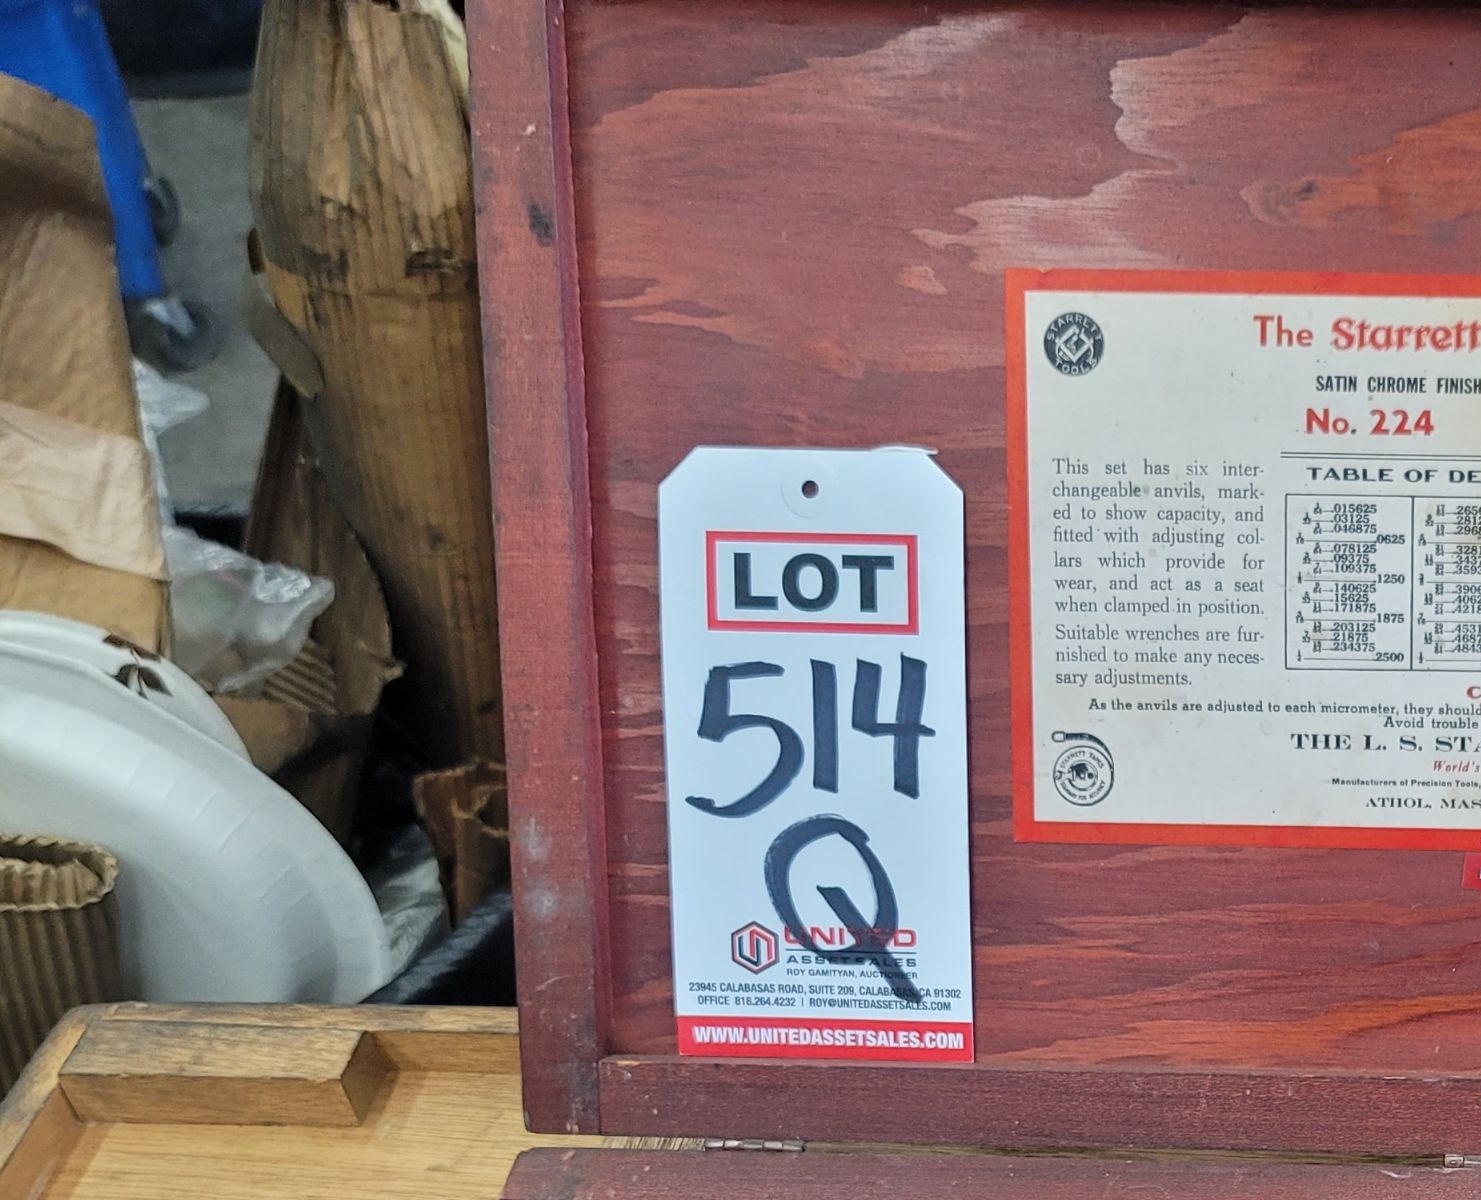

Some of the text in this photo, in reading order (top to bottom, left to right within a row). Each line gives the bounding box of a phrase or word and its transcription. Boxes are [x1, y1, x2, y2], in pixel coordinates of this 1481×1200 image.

[1047, 314, 1103, 342] STARRETT
[1253, 314, 1314, 347] The
[1056, 358, 1097, 376] TOOLS
[1315, 375, 1481, 395] SATIN CHROME FINISH
[1306, 408, 1435, 436] No. 224
[1052, 457, 1264, 477] This set has six inter-
[1306, 467, 1394, 482] TABLE
[1403, 469, 1438, 483] OF
[1052, 480, 1264, 501] changeable anvils, mark-
[1053, 503, 1264, 525] ed to show capacity, and
[1053, 525, 1264, 548] fitted with adjusting col-
[733, 551, 895, 613] LOT
[1056, 667, 1192, 688] sary adjustments.
[1088, 698, 1107, 710] As
[1111, 698, 1132, 710] the
[1137, 698, 1178, 711] anvils
[1182, 703, 1202, 711] are
[1207, 699, 1263, 714] adjusted
[1268, 702, 1280, 712] to
[1285, 700, 1316, 713] each
[1319, 702, 1399, 716] micrometer,
[1404, 702, 1434, 717] they
[685, 652, 937, 819] 514
[1290, 733, 1351, 750] THE
[1363, 734, 1387, 751] L.
[1399, 736, 1423, 752] S.
[1433, 760, 1480, 772] World's
[1332, 777, 1397, 786] Manufacturers
[1400, 779, 1408, 787] of
[1410, 779, 1452, 787] Precision
[1455, 779, 1481, 790] Tools,
[764, 813, 924, 1004] Q
[786, 968, 806, 977] ROY
[808, 969, 857, 979] GAMITYAN,
[688, 982, 718, 992] 23945
[719, 982, 776, 994] CALABASAS
[777, 984, 808, 996] ROAD,
[809, 985, 836, 996] SUITE
[837, 985, 857, 997] 209,
[933, 988, 962, 999] 91302
[697, 995, 730, 1006] OFFICE
[734, 996, 796, 1007] 818.264.4232
[693, 1025, 965, 1050] WWW.UNITEDASSETSALES.COM
